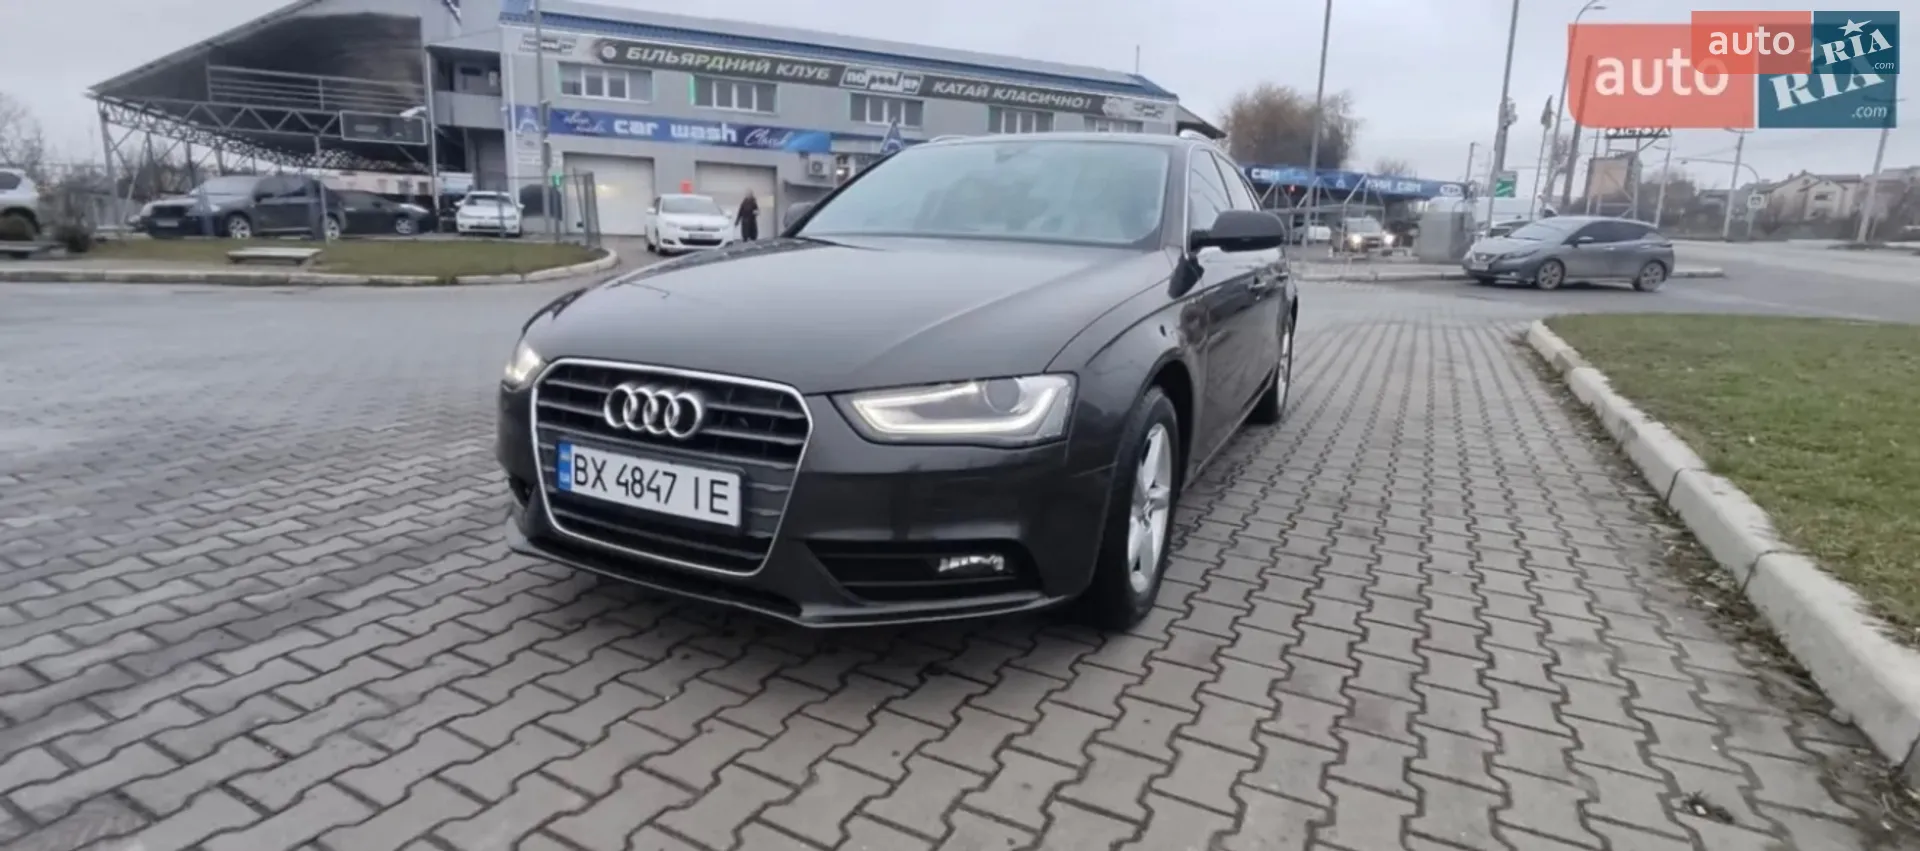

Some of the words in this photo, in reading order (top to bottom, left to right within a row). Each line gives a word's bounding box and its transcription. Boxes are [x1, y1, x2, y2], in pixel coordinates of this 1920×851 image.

[626, 45, 770, 74] БІЛЬЯРДНИЙ
[776, 61, 832, 80] КЛУБ
[932, 80, 990, 98] КАТАЙ
[613, 118, 659, 135] car
[669, 122, 737, 143] wash
[574, 453, 607, 492] BX
[616, 463, 677, 505] 4847
[694, 476, 729, 516] IE
